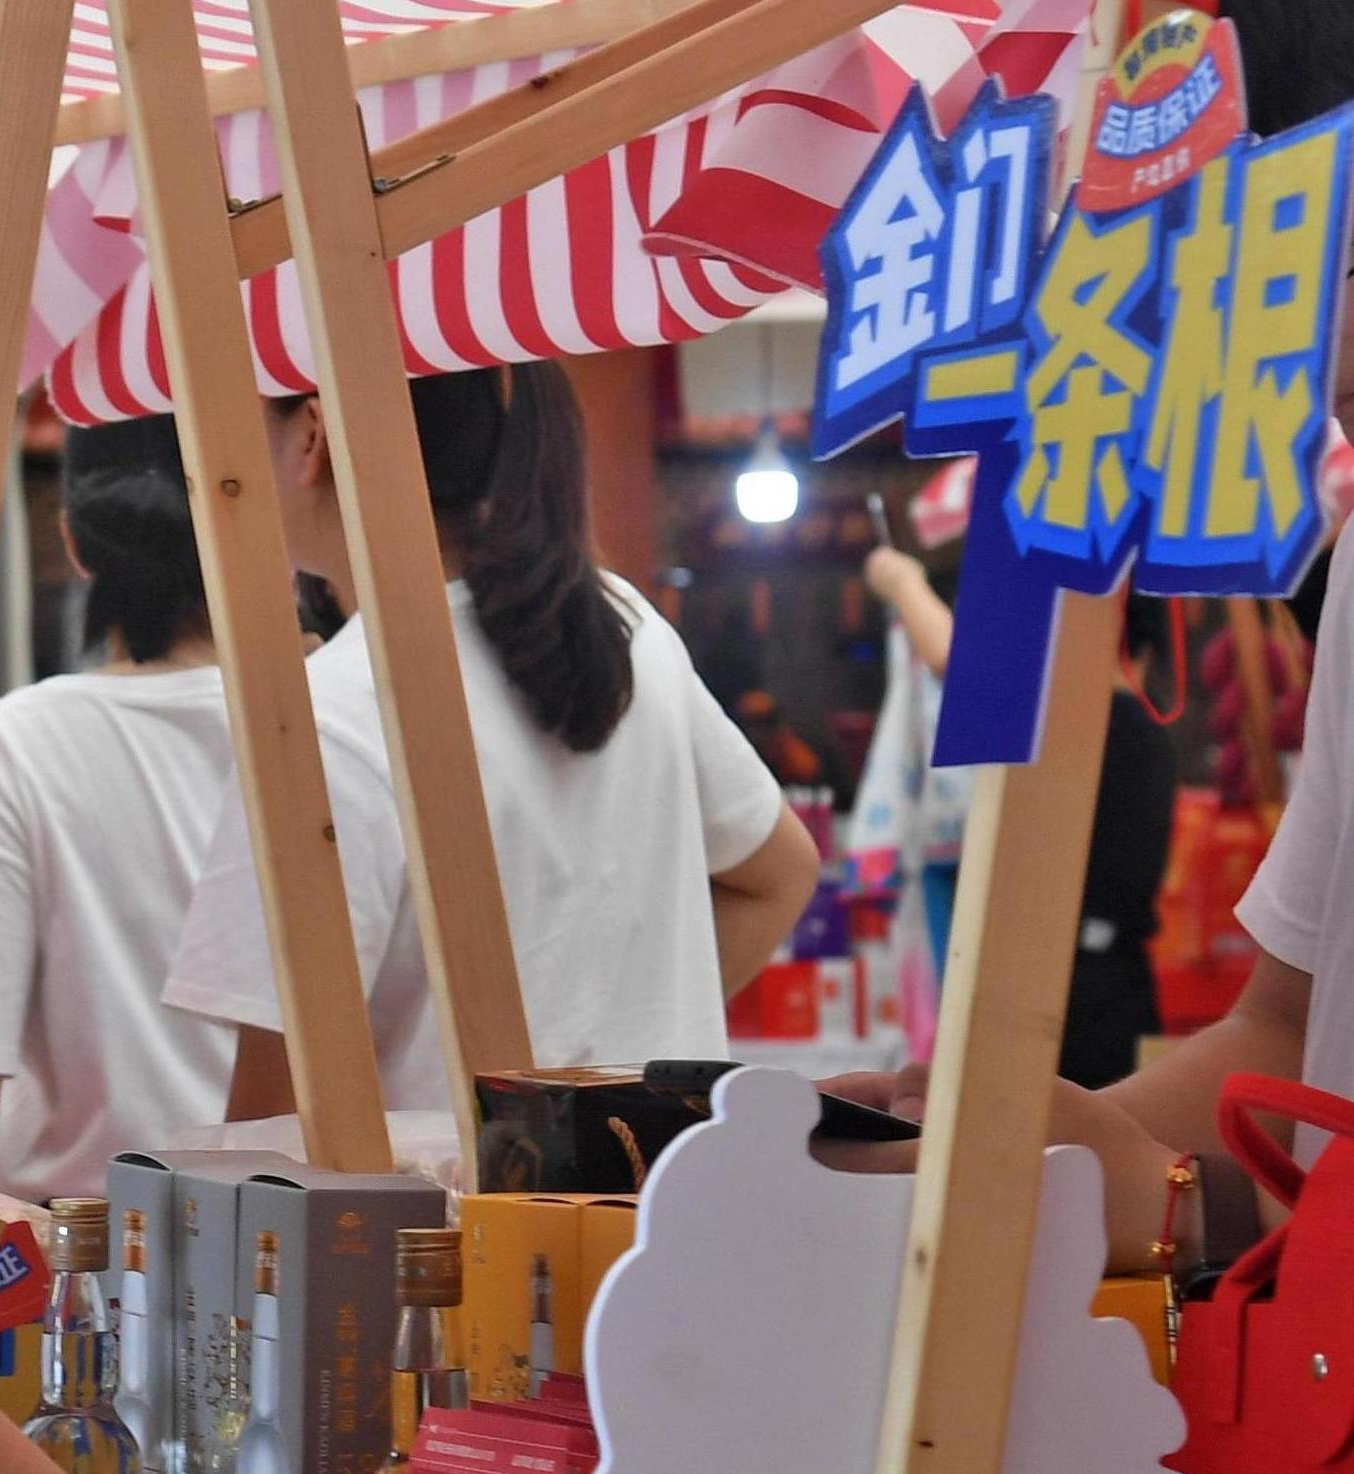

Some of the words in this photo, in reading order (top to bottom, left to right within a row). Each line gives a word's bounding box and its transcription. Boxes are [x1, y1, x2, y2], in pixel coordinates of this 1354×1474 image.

[1096, 54, 1224, 155] 品质保证
[925, 126, 1342, 541] 一条根
